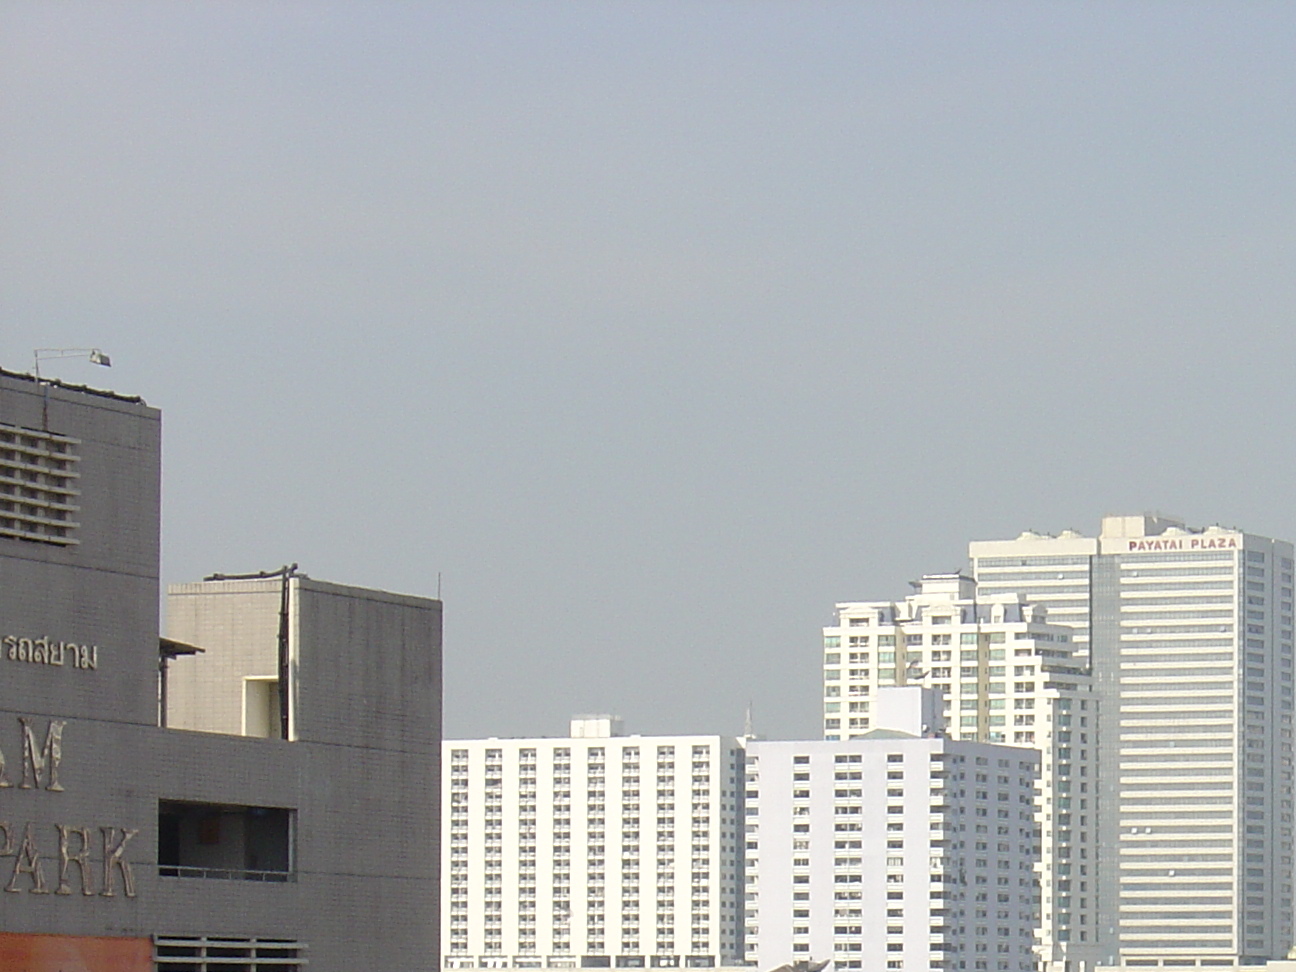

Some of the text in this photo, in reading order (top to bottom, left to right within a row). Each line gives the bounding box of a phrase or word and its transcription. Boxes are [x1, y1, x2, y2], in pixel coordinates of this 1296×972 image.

[1128, 537, 1237, 552] PAYATAI PLAZA
[0, 634, 98, 670] รถสยาม
